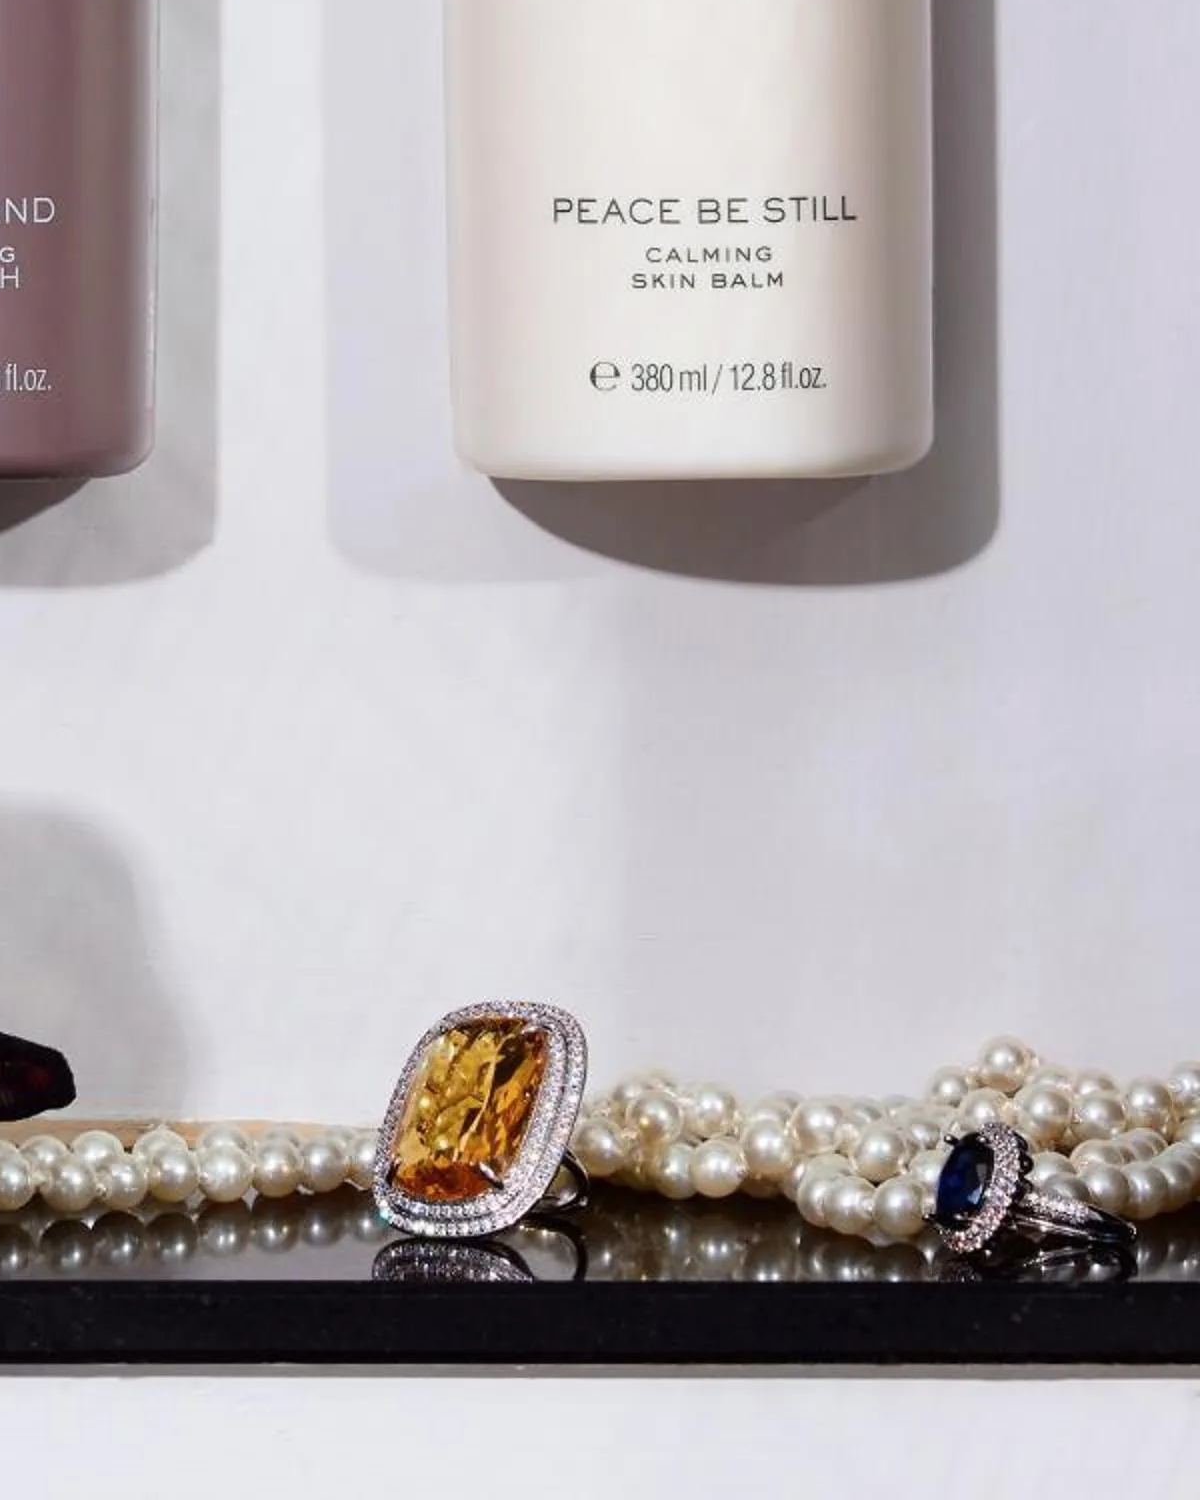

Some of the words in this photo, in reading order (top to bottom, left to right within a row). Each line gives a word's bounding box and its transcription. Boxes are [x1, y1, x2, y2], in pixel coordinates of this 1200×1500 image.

[553, 197, 681, 224] PEACE
[697, 197, 750, 224] BE
[762, 195, 858, 224] STILL
[645, 246, 774, 264] CALMING
[631, 272, 696, 290] SKIN
[711, 271, 785, 290] BALM
[631, 362, 674, 392] 380
[729, 361, 776, 392] 12.8
